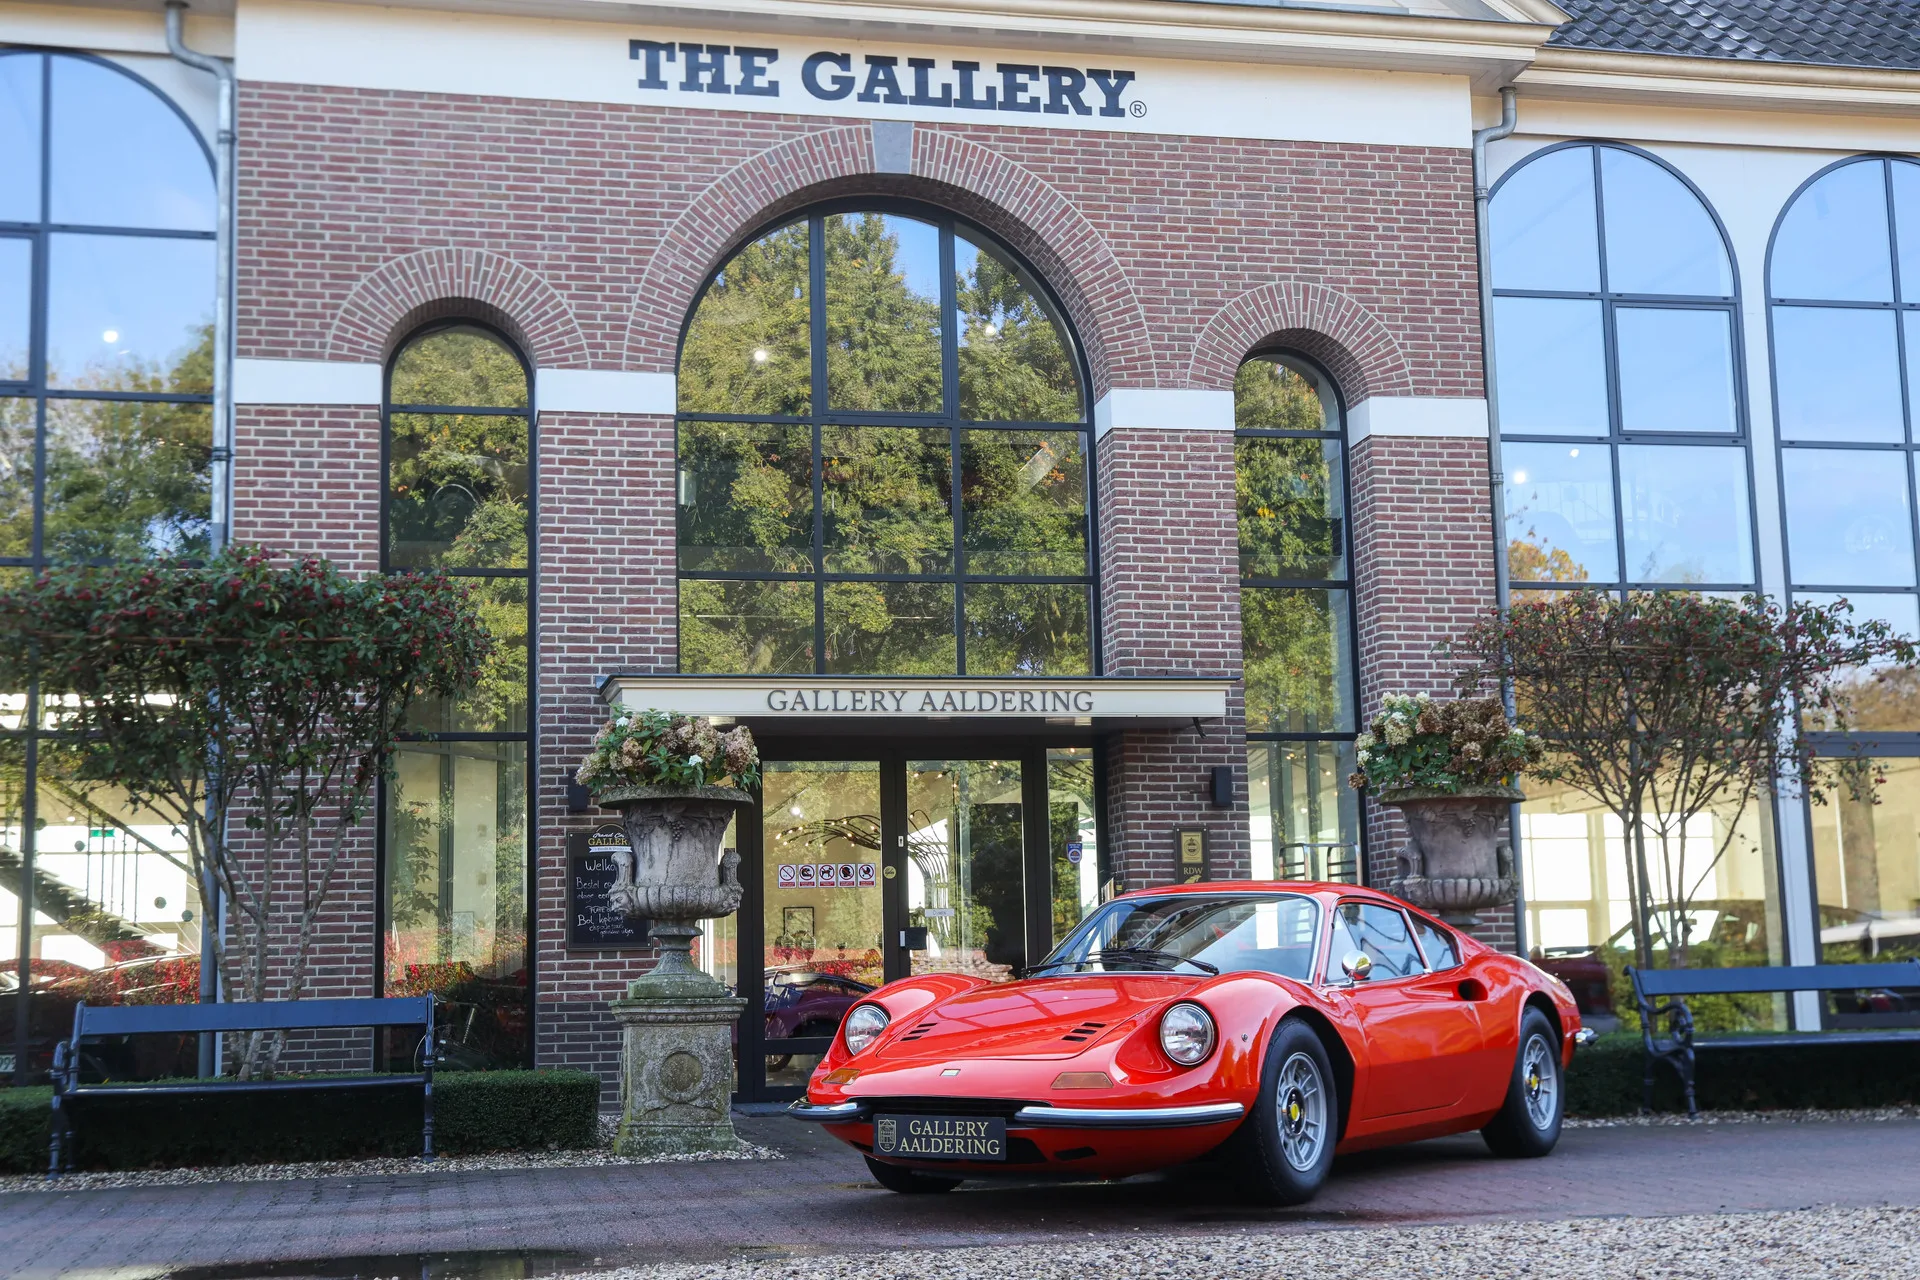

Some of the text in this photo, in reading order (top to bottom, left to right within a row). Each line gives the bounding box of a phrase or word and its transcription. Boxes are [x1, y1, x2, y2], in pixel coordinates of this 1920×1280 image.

[629, 39, 780, 97] THE
[801, 51, 1136, 118] GALLERY
[767, 690, 1094, 712] GALLERY AALDERING
[585, 859, 615, 871] Welko
[909, 1120, 989, 1136] GALLERY
[898, 1137, 1000, 1155] AALDERING
